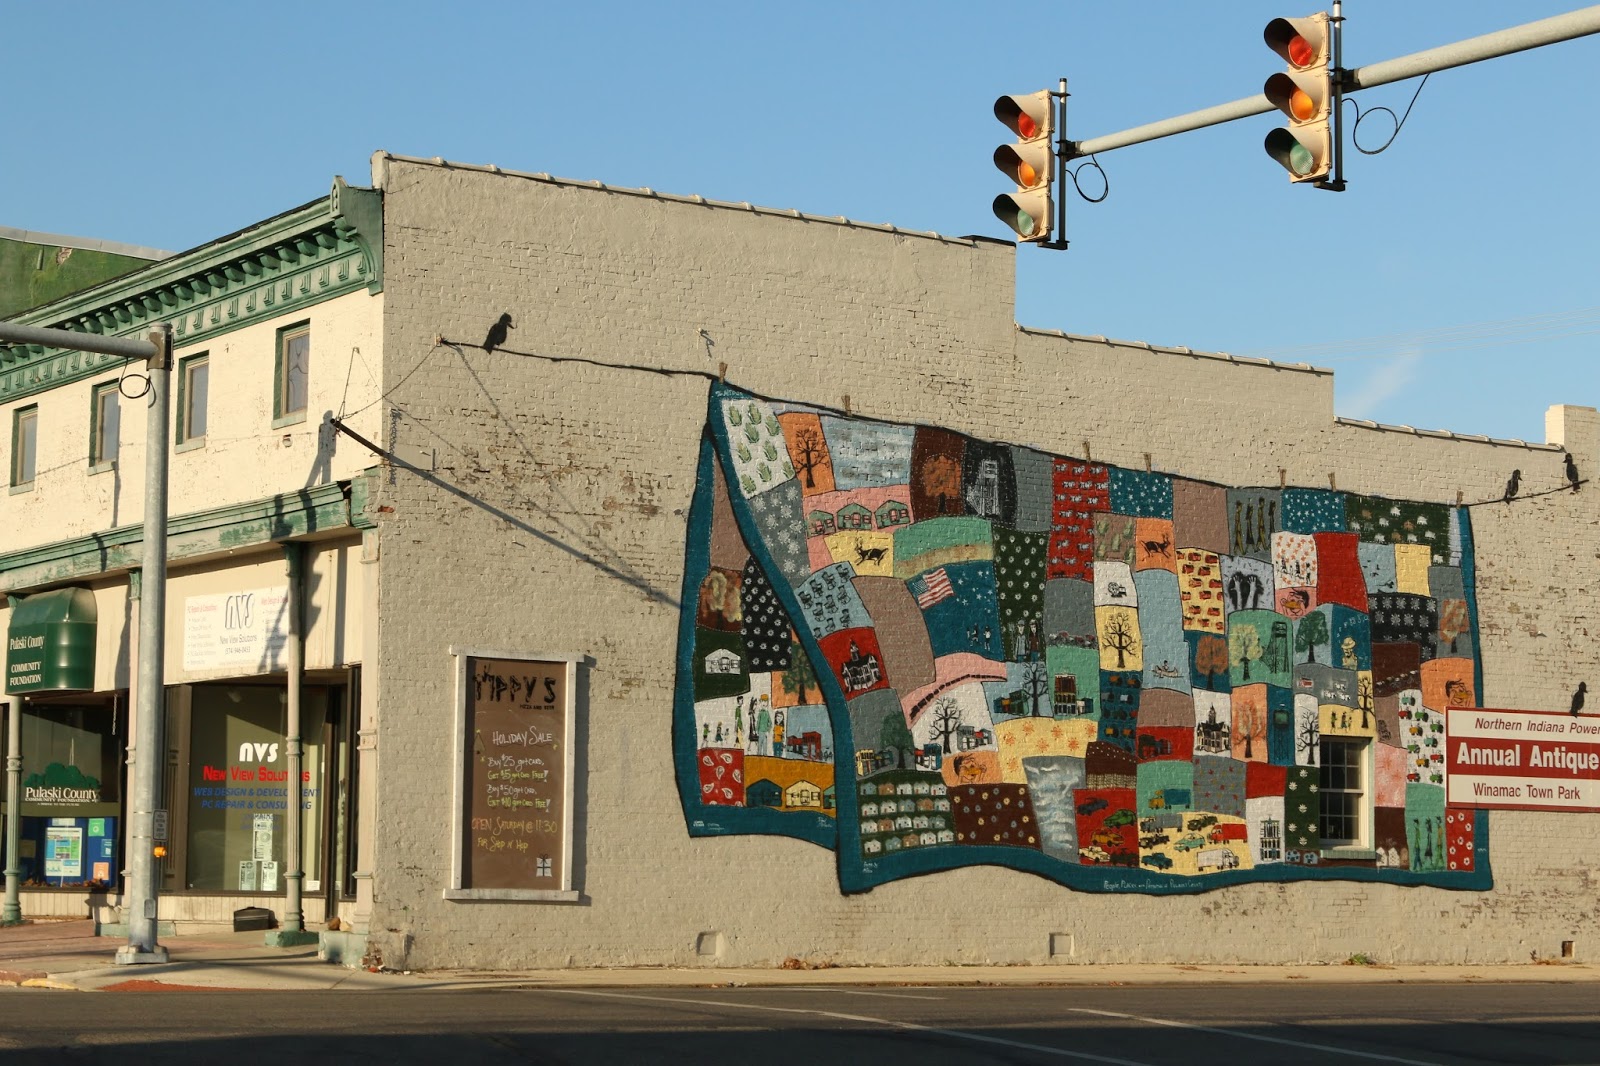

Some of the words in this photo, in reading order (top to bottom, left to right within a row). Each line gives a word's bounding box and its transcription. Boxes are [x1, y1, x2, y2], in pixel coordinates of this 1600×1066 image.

[9, 636, 27, 650] Pulaski
[27, 636, 45, 649] County
[11, 661, 42, 673] COMMUNITY
[9, 674, 42, 686] FOUNDATION
[1475, 717, 1522, 731] Northern
[1527, 720, 1565, 733] Indiana
[1569, 722, 1600, 734] Power
[492, 731, 528, 747] HOLIDAY
[529, 725, 553, 745] SALE
[501, 753, 515, 767] $25
[1456, 742, 1520, 766] Annual
[1529, 745, 1600, 774] Antique
[25, 786, 61, 799] Pulaski
[63, 787, 97, 799] County
[194, 787, 213, 797] WEB
[215, 787, 247, 797] DESIGN
[248, 787, 255, 797] &
[1473, 782, 1521, 797] Winamac
[1526, 784, 1553, 798] Town
[1558, 786, 1581, 799] Park
[214, 800, 246, 809] REPAIR
[247, 800, 254, 809] &
[472, 818, 492, 831] OPEN
